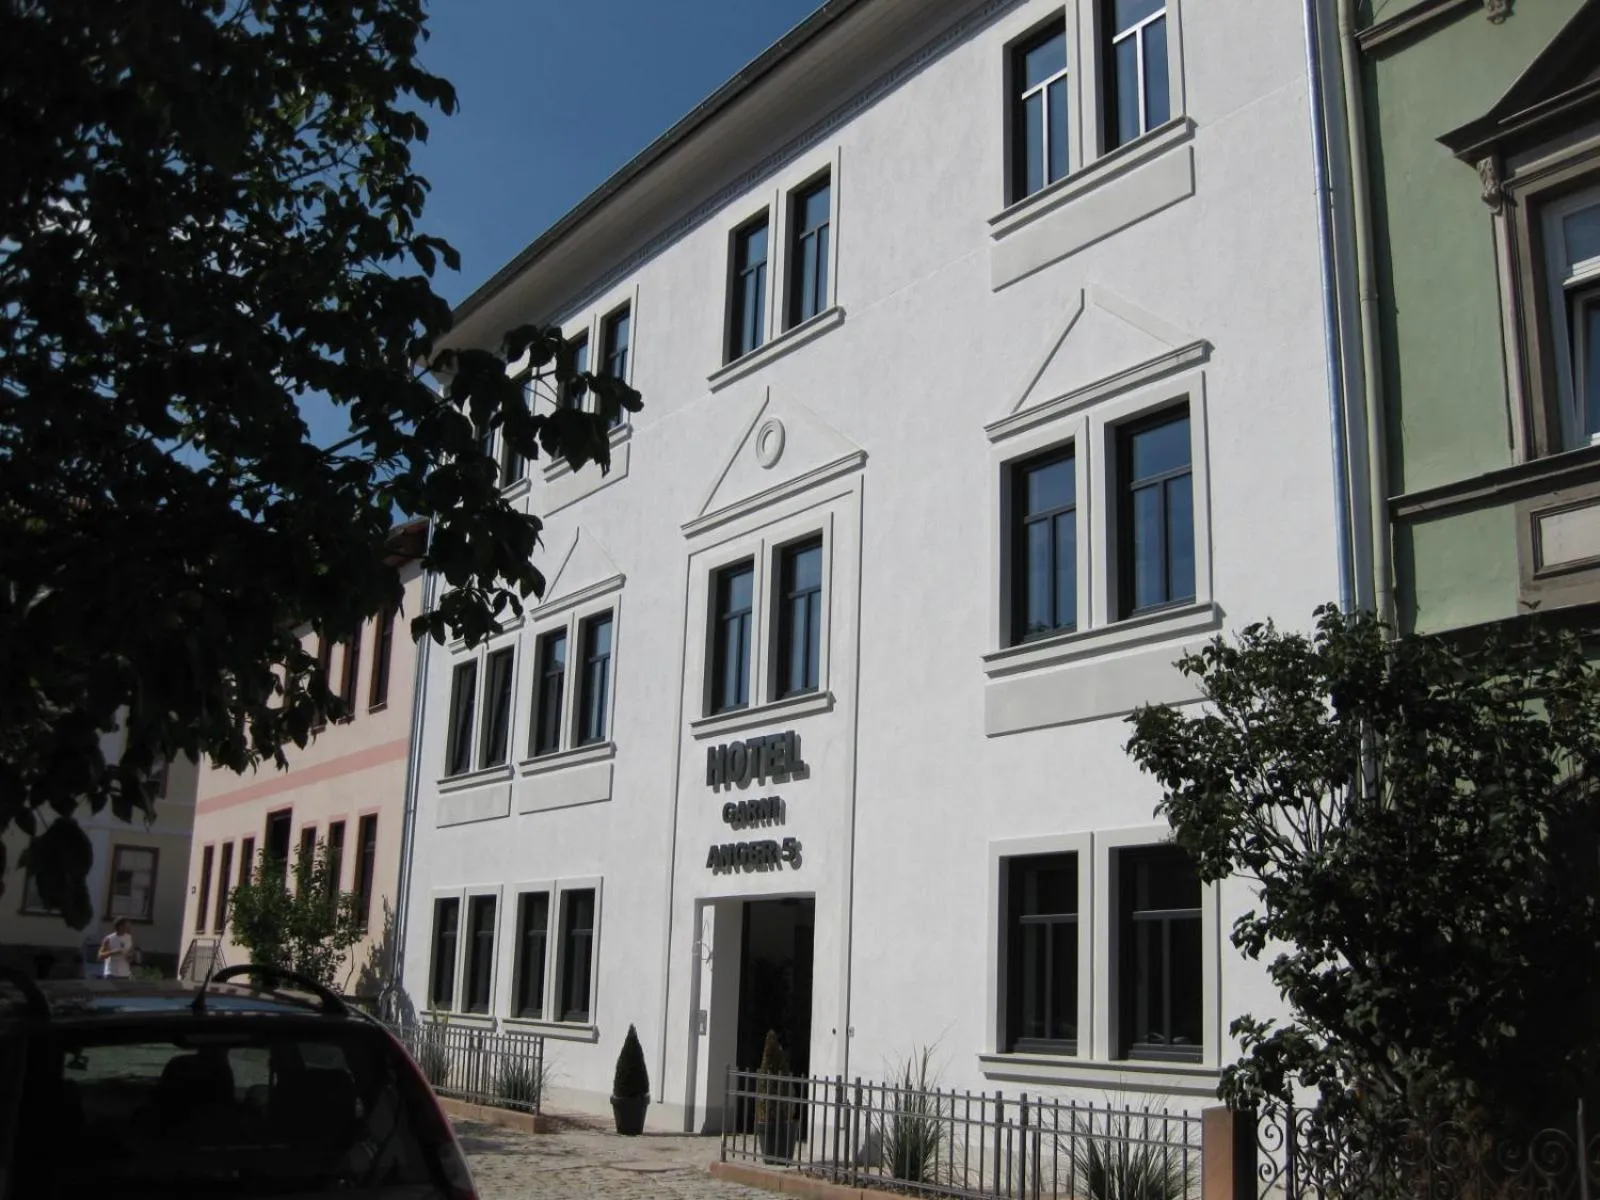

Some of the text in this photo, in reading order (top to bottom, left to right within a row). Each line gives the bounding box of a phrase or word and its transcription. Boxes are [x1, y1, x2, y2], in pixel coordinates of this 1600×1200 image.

[706, 730, 806, 788] HOTEL
[722, 796, 782, 826] GARNI
[706, 837, 800, 869] ANGER 5
